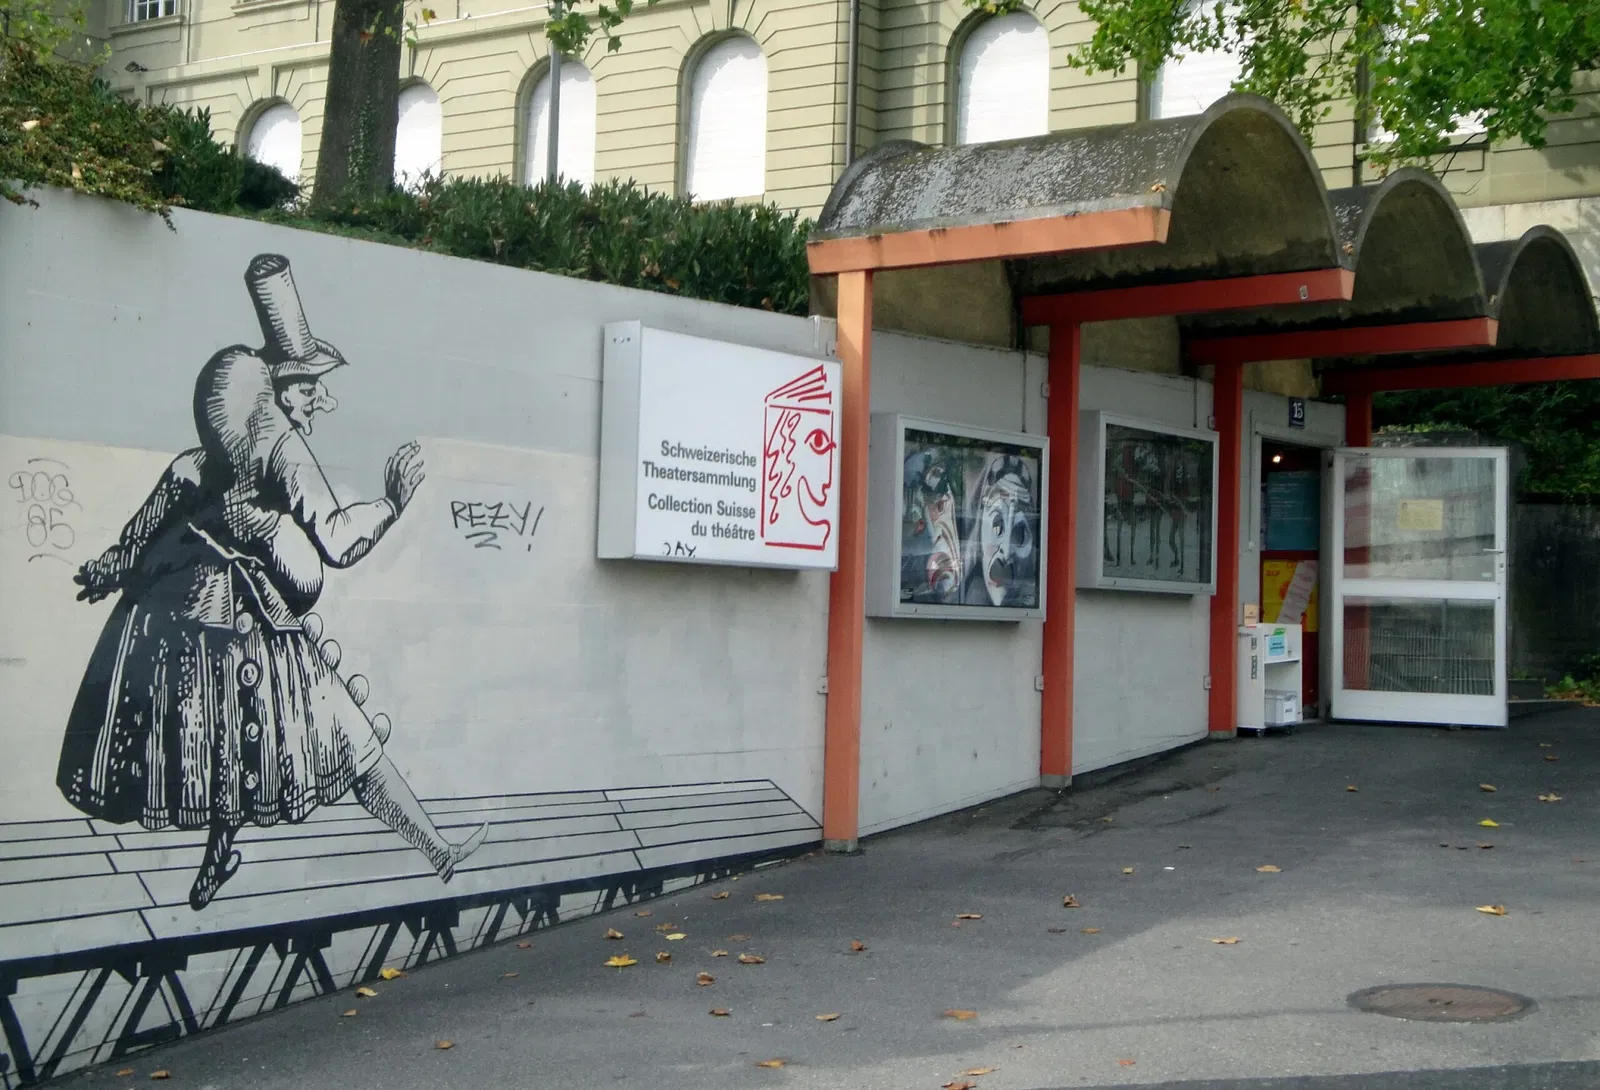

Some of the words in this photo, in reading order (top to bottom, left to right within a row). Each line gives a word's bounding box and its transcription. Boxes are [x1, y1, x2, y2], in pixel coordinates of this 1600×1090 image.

[1293, 401, 1304, 419] 15
[661, 439, 757, 467] Schweizerische
[642, 460, 757, 493] Theatersammlung
[648, 493, 713, 515] Collection
[717, 500, 756, 519] Suisse
[691, 520, 707, 538] du
[711, 521, 756, 541] théâtre
